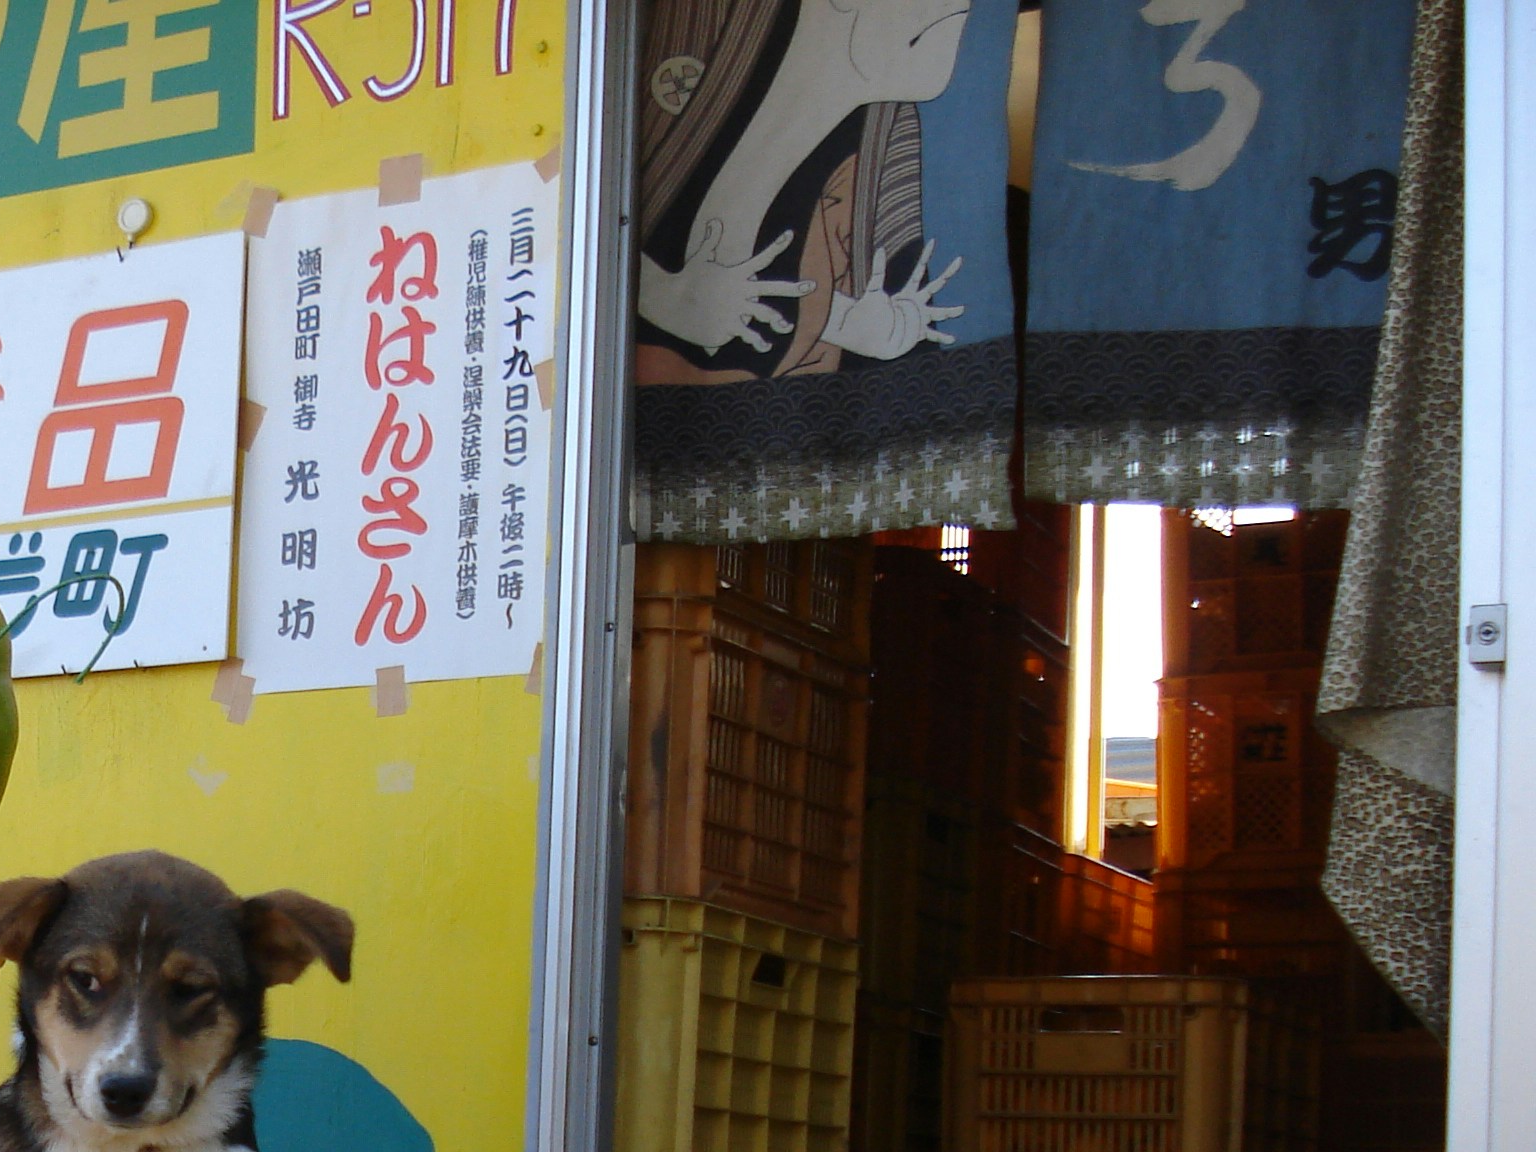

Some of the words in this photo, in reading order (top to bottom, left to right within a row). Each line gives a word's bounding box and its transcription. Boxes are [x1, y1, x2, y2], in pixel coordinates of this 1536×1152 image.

[1306, 168, 1400, 282] 男
[355, 225, 439, 647] ねはんさん
[277, 460, 320, 641] 光明坊
